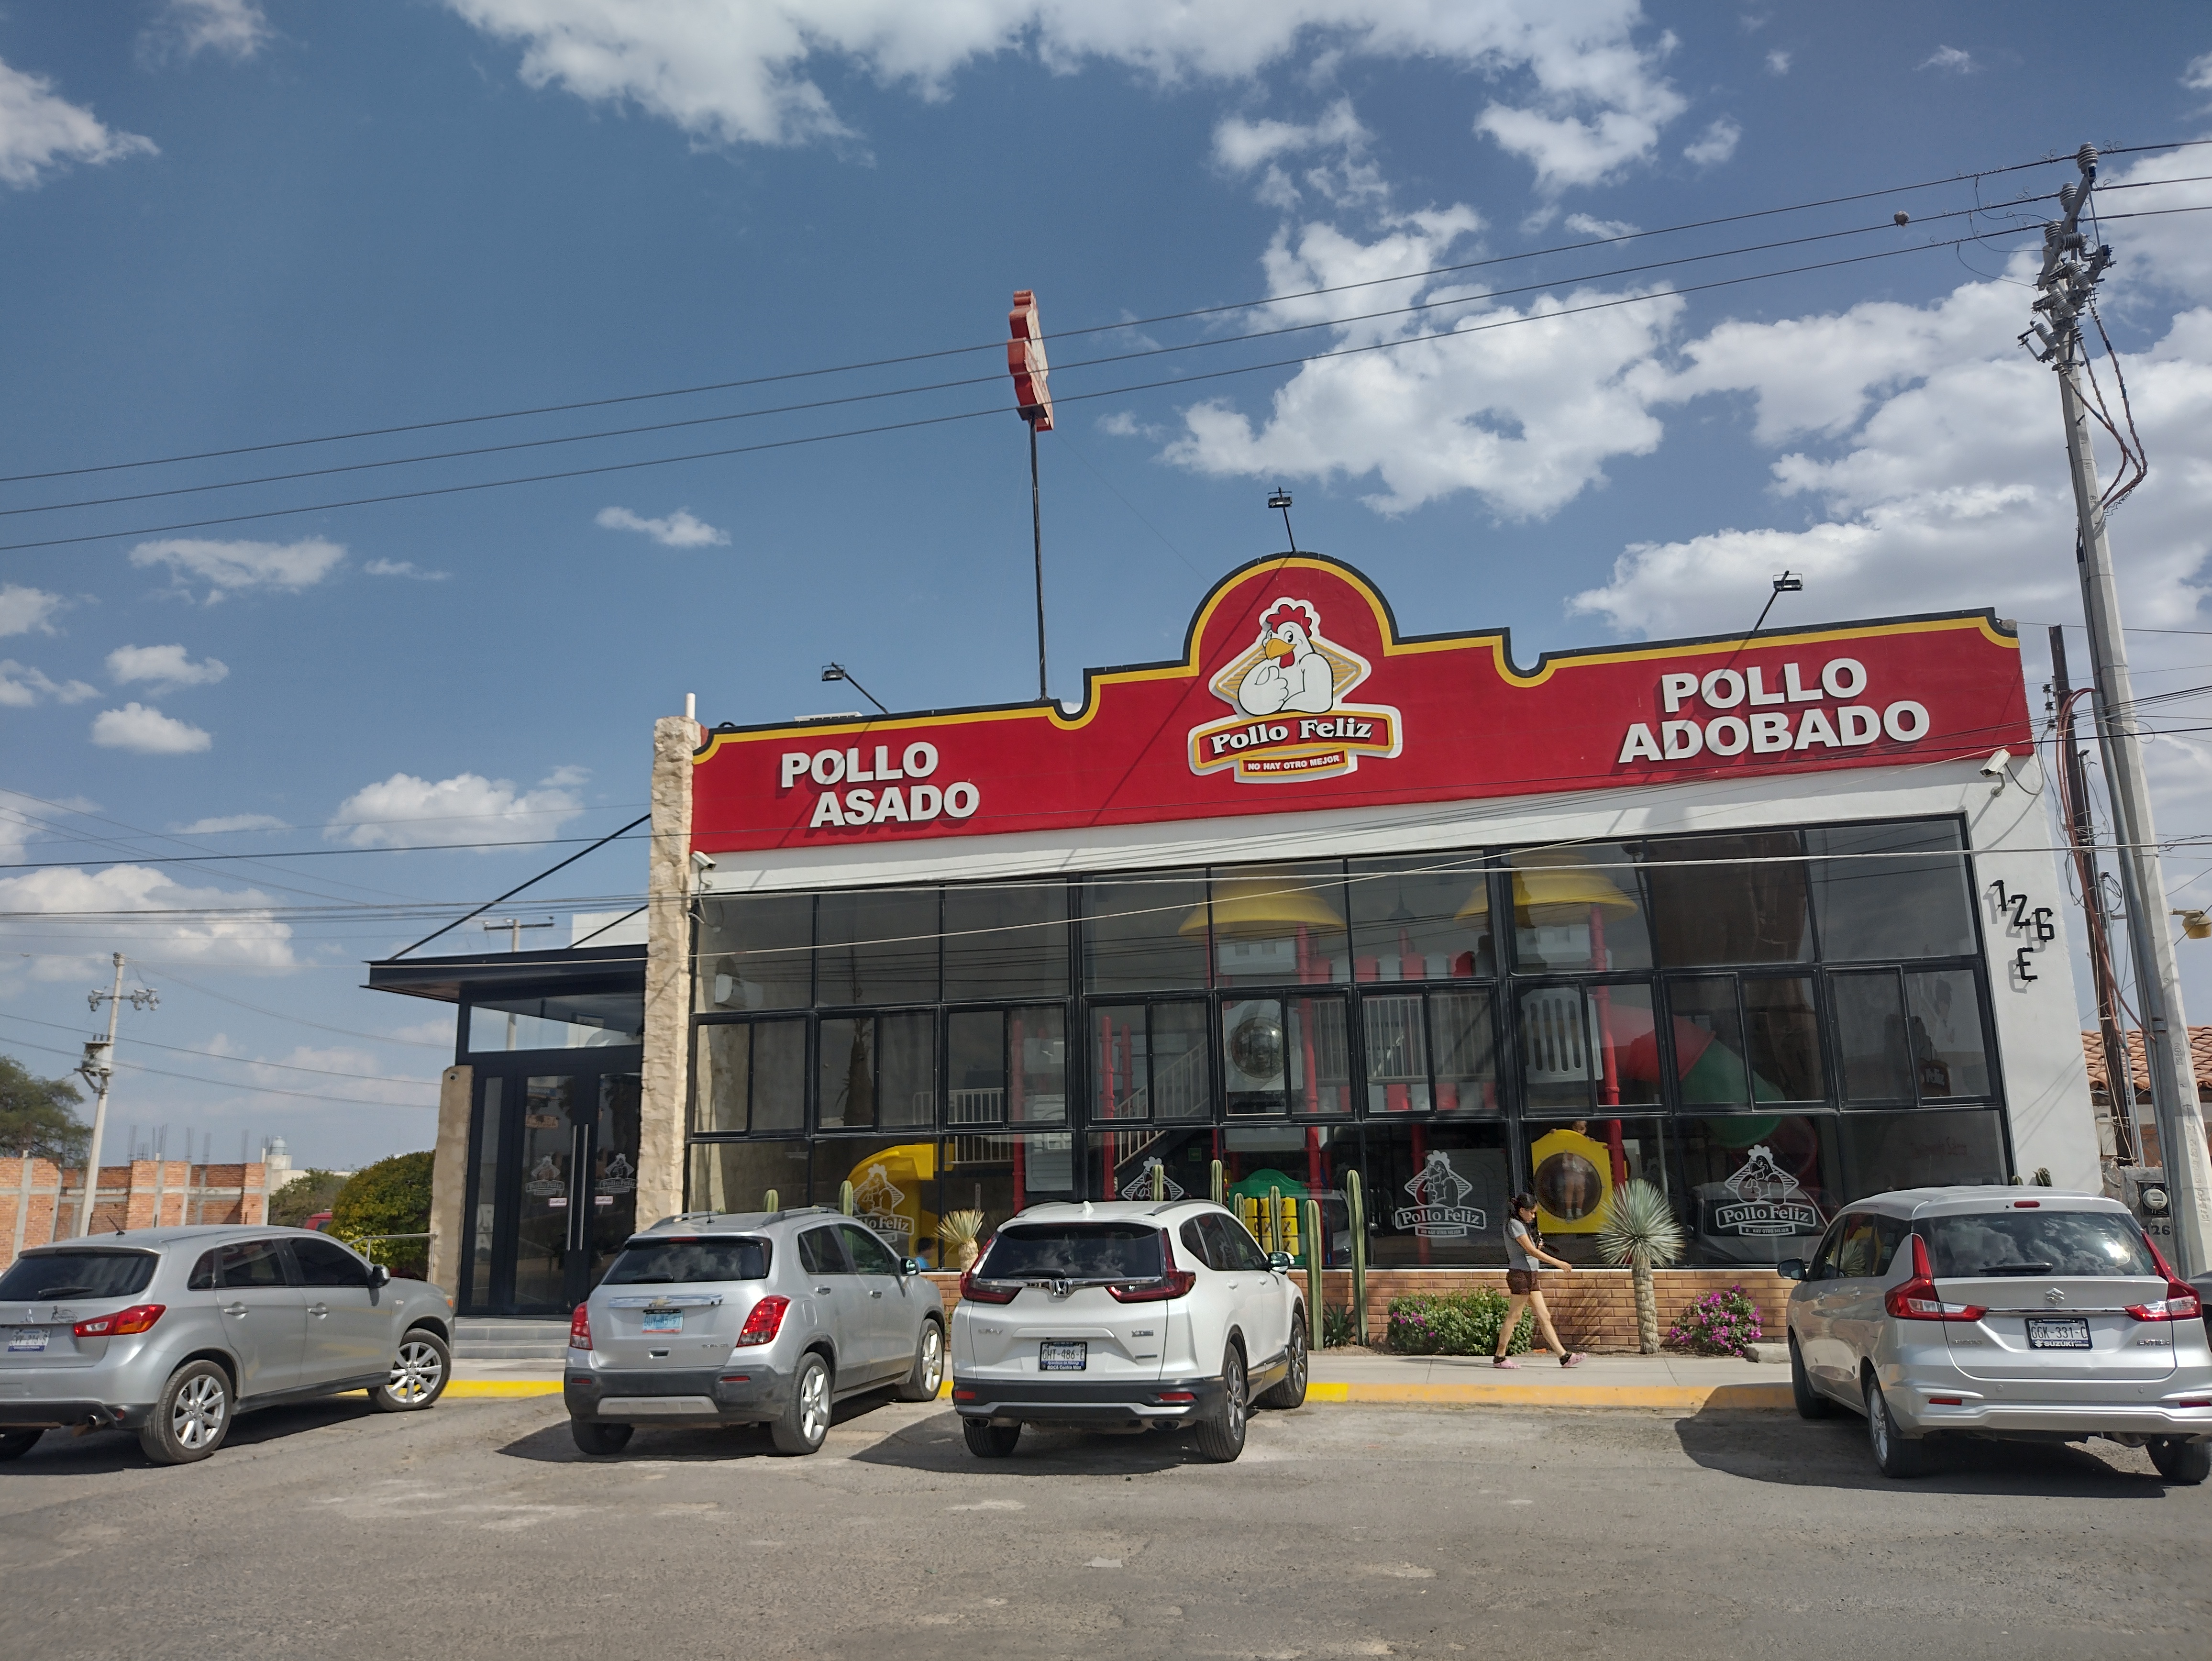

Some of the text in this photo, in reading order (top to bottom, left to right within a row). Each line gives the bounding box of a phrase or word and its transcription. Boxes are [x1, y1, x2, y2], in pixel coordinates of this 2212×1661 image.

[1661, 657, 1867, 713] POLLO
[1210, 717, 1374, 755] Pollo Feliz
[1618, 700, 1930, 764] ADOBADO
[781, 742, 939, 788] POLLO
[1248, 755, 1339, 771] NO HAY OTRO MEJOR
[809, 781, 980, 828] ASADO
[1990, 880, 2055, 941] 126
[2017, 947, 2038, 981] E
[879, 1217, 909, 1231] Feliz
[1401, 1208, 1480, 1225] Pollo Feliz
[1722, 1206, 1809, 1223] Pollo Feliz
[2143, 1225, 2170, 1235] 126
[2031, 1326, 2088, 1339] GGK-331-C
[1043, 1349, 1084, 1360] GHT-486-E
